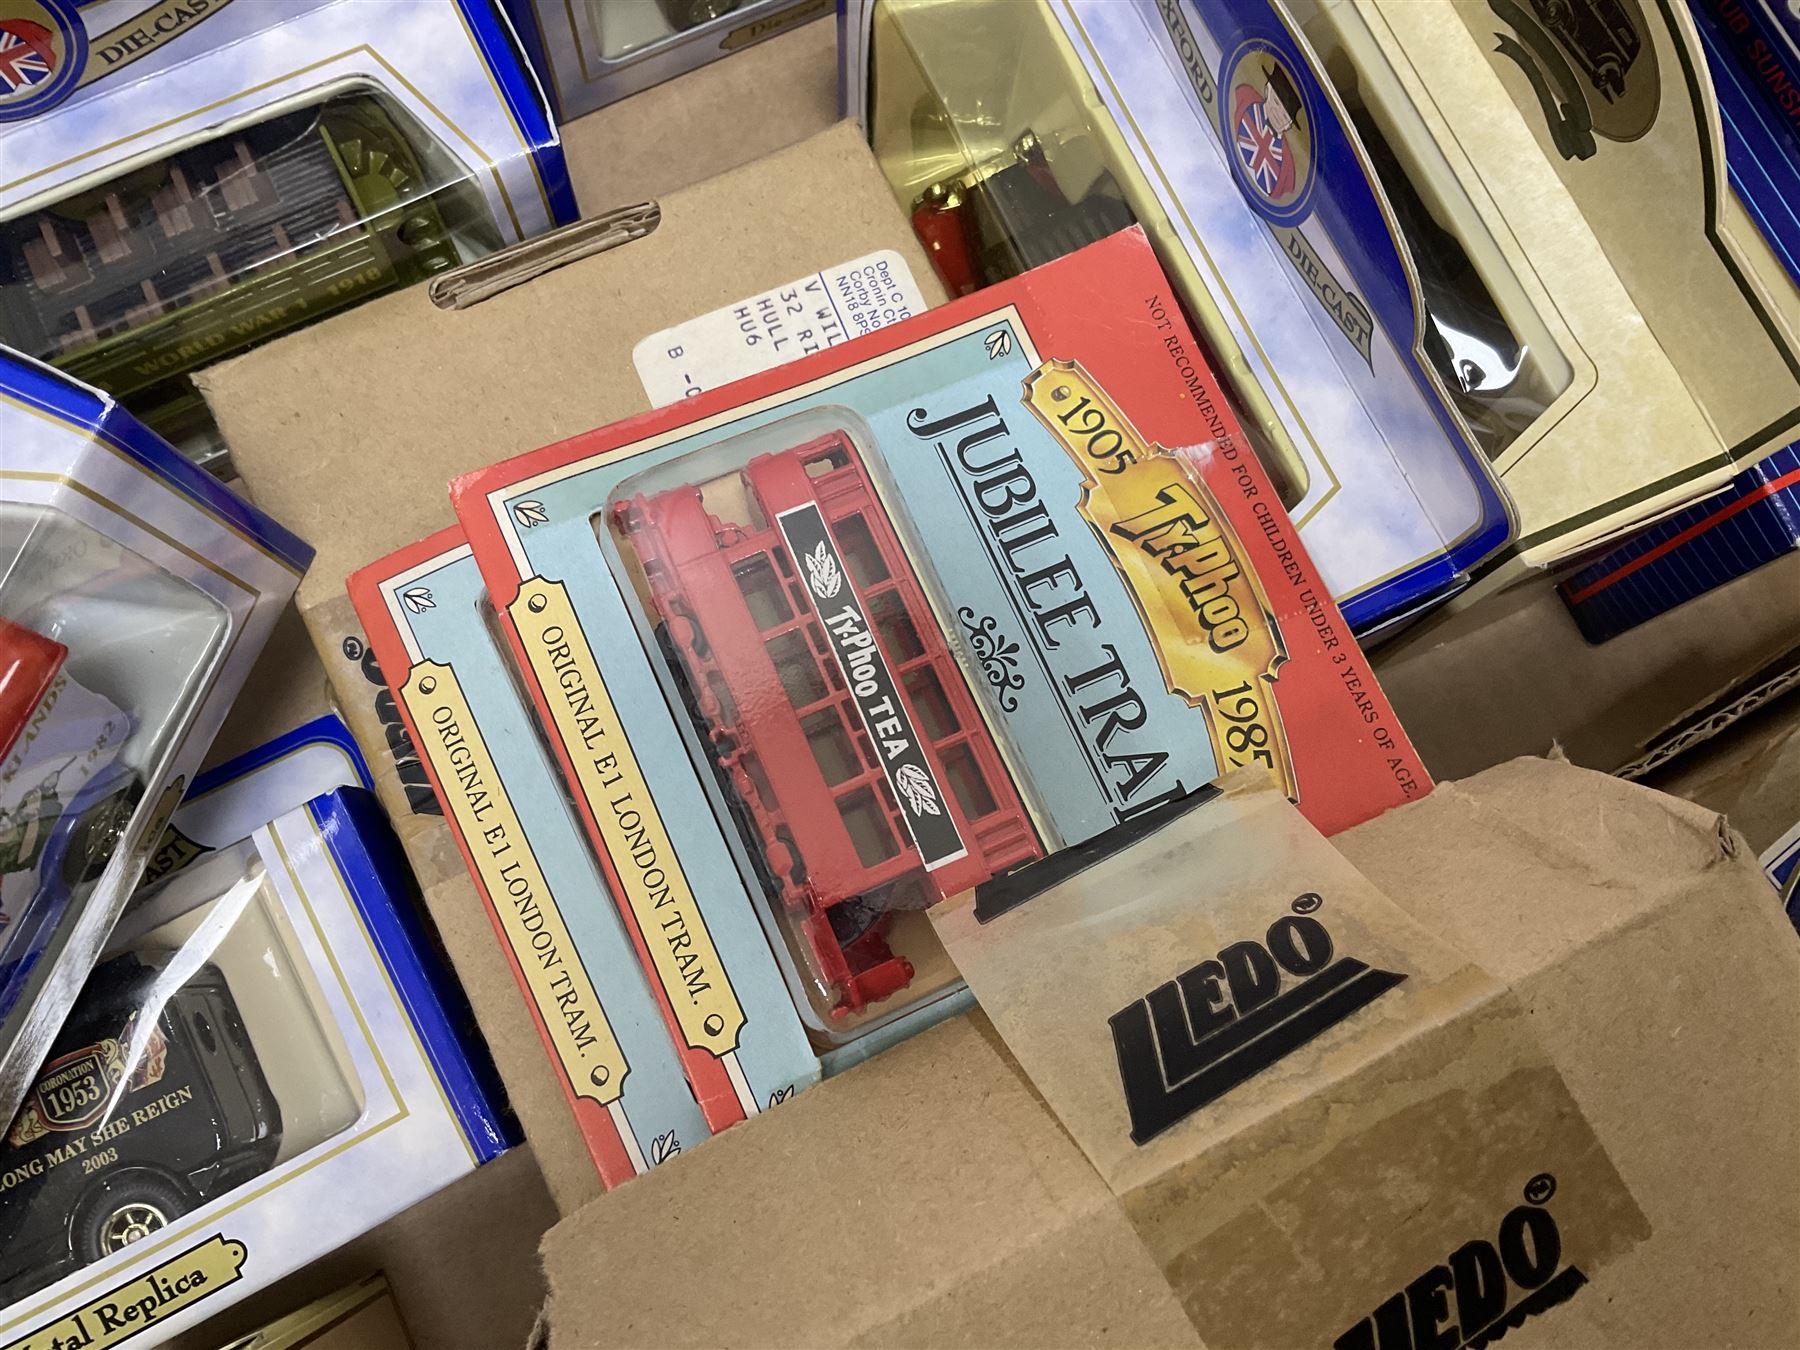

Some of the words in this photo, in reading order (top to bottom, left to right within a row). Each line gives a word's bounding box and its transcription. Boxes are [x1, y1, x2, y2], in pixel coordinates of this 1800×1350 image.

[96, 0, 220, 65] DIE-CAS
[780, 288, 803, 314] 32
[804, 280, 822, 293] V
[836, 275, 859, 311] NN18
[850, 270, 872, 307] Corby
[863, 265, 886, 307] Cronin
[876, 260, 898, 289] Dept
[891, 292, 904, 304] C
[1288, 233, 1368, 346] DIE-CAST
[134, 332, 226, 376] WORLD
[231, 305, 288, 336] WAR
[667, 345, 684, 359] B
[733, 306, 763, 346] HU6
[757, 298, 789, 352] HULL
[1056, 396, 1138, 475] 1905
[907, 394, 1102, 651] JUBILEE
[1145, 295, 1173, 330] NOT
[1164, 335, 1239, 462] RECOMMENDED
[1231, 463, 1259, 500] FOR
[1252, 501, 1306, 587] CHILDREN
[1299, 588, 1340, 651] UNDER
[1332, 652, 1348, 665] 3
[1341, 666, 1379, 724] YEARS
[1372, 727, 1396, 752] OF
[1386, 757, 1419, 798] AGE.
[868, 695, 910, 761] TEA
[541, 624, 605, 751] ORIGINAL
[610, 792, 676, 910] LONDON
[661, 911, 712, 1007] TRAM.
[432, 705, 495, 823] ORIGINAL
[499, 860, 564, 971] LONDON
[549, 970, 599, 1059] TRAM.
[39, 1059, 95, 1094] CORONATION
[47, 1075, 101, 1119] 1953
[44, 1135, 88, 1169] MAY
[90, 1116, 131, 1148] SHE
[131, 1085, 194, 1127] REIGN
[81, 1146, 119, 1175] 2003
[93, 1269, 208, 1336] Replica
